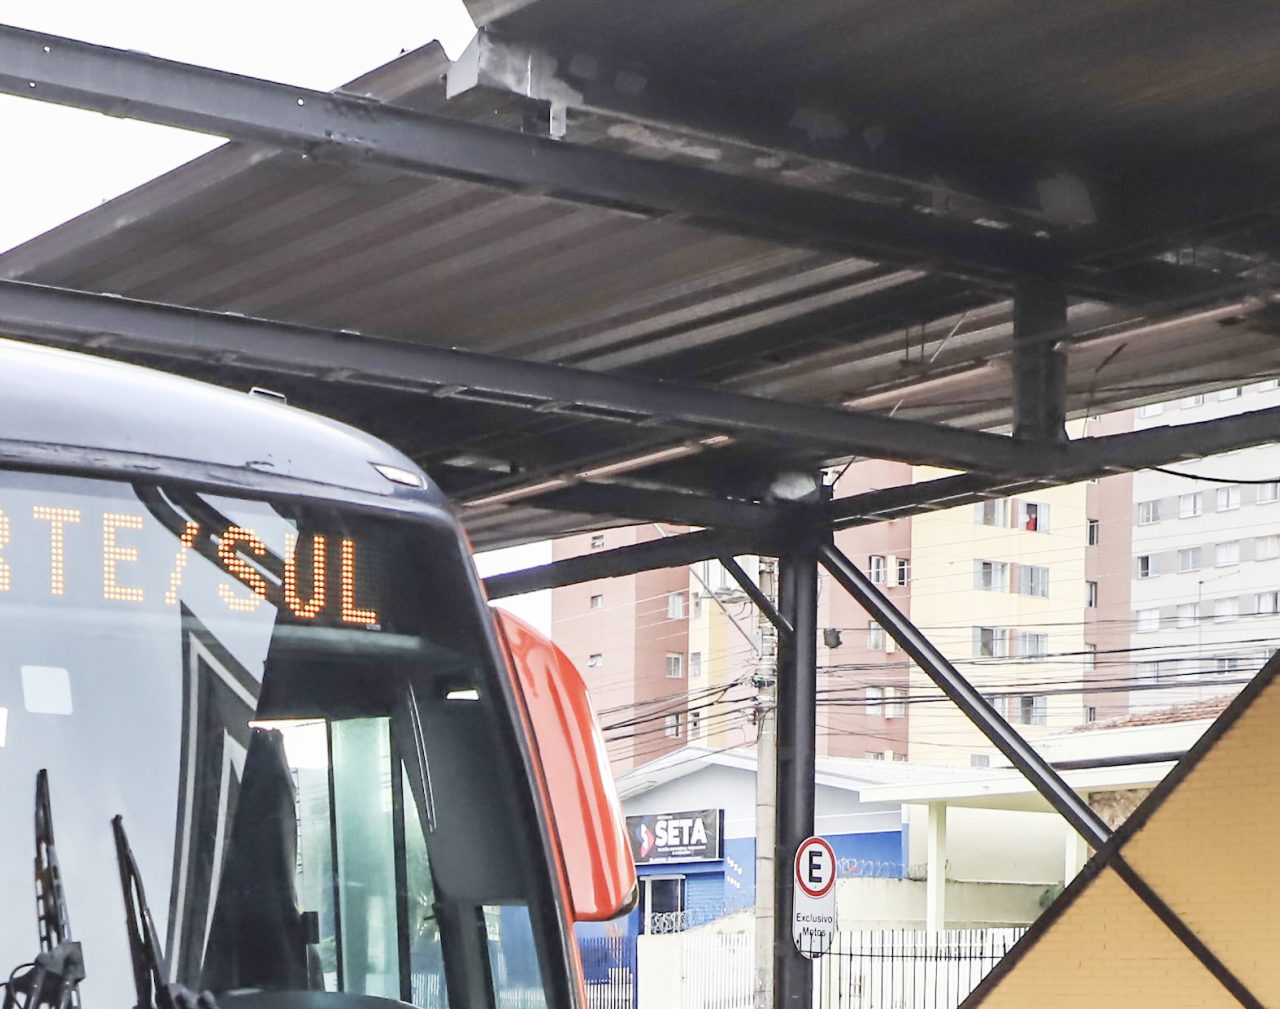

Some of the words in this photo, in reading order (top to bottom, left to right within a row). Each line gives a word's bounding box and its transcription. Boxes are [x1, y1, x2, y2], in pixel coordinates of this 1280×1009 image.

[655, 817, 707, 847] SETA
[808, 850, 823, 883] E
[796, 912, 833, 924] Exclusivo
[802, 926, 826, 937] Motos
